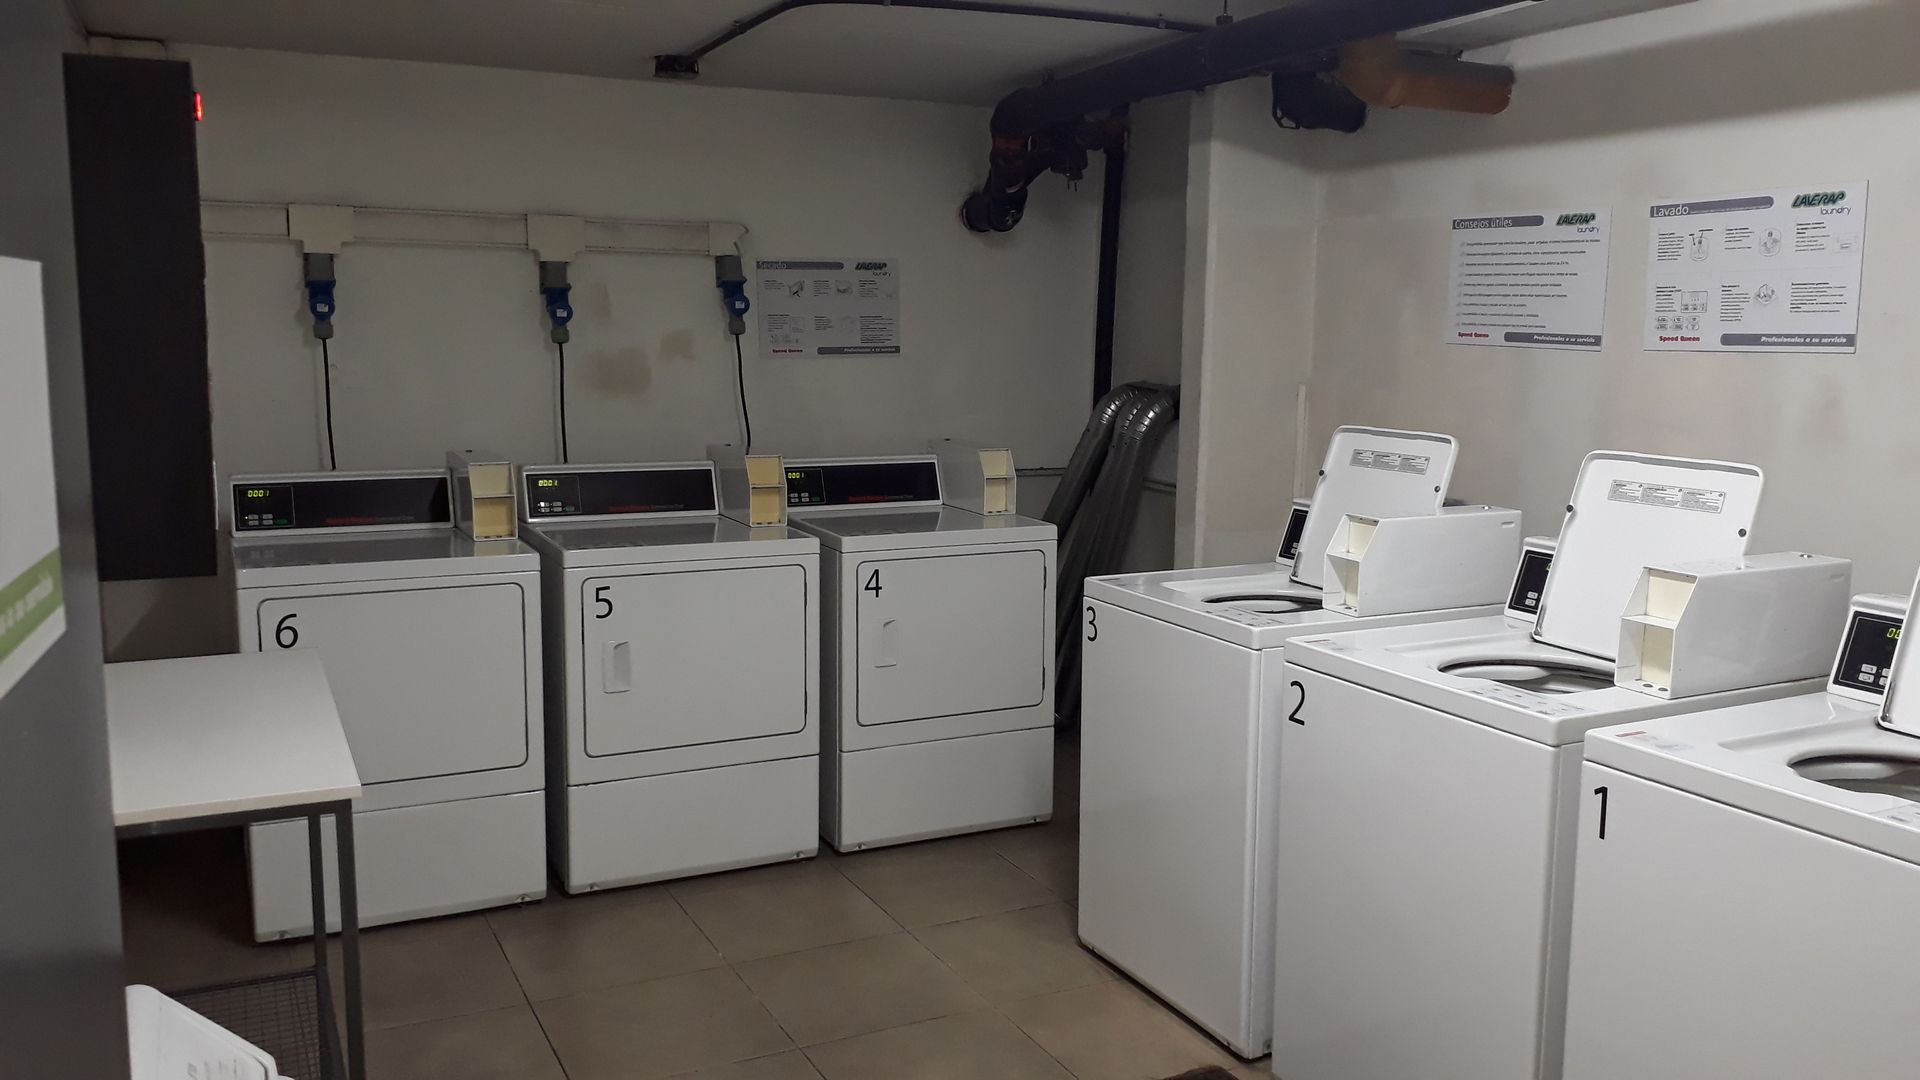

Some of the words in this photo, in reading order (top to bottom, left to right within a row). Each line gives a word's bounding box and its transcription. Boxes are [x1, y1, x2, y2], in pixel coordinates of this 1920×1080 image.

[1455, 219, 1489, 230] Consejos
[1653, 204, 1689, 217] Lavado
[247, 489, 270, 498] 0001
[864, 569, 883, 598] 4
[594, 586, 614, 619] 5
[274, 613, 299, 649] 6
[1086, 606, 1099, 642] 3
[1288, 680, 1306, 726] 2
[1594, 786, 1608, 840] 1
